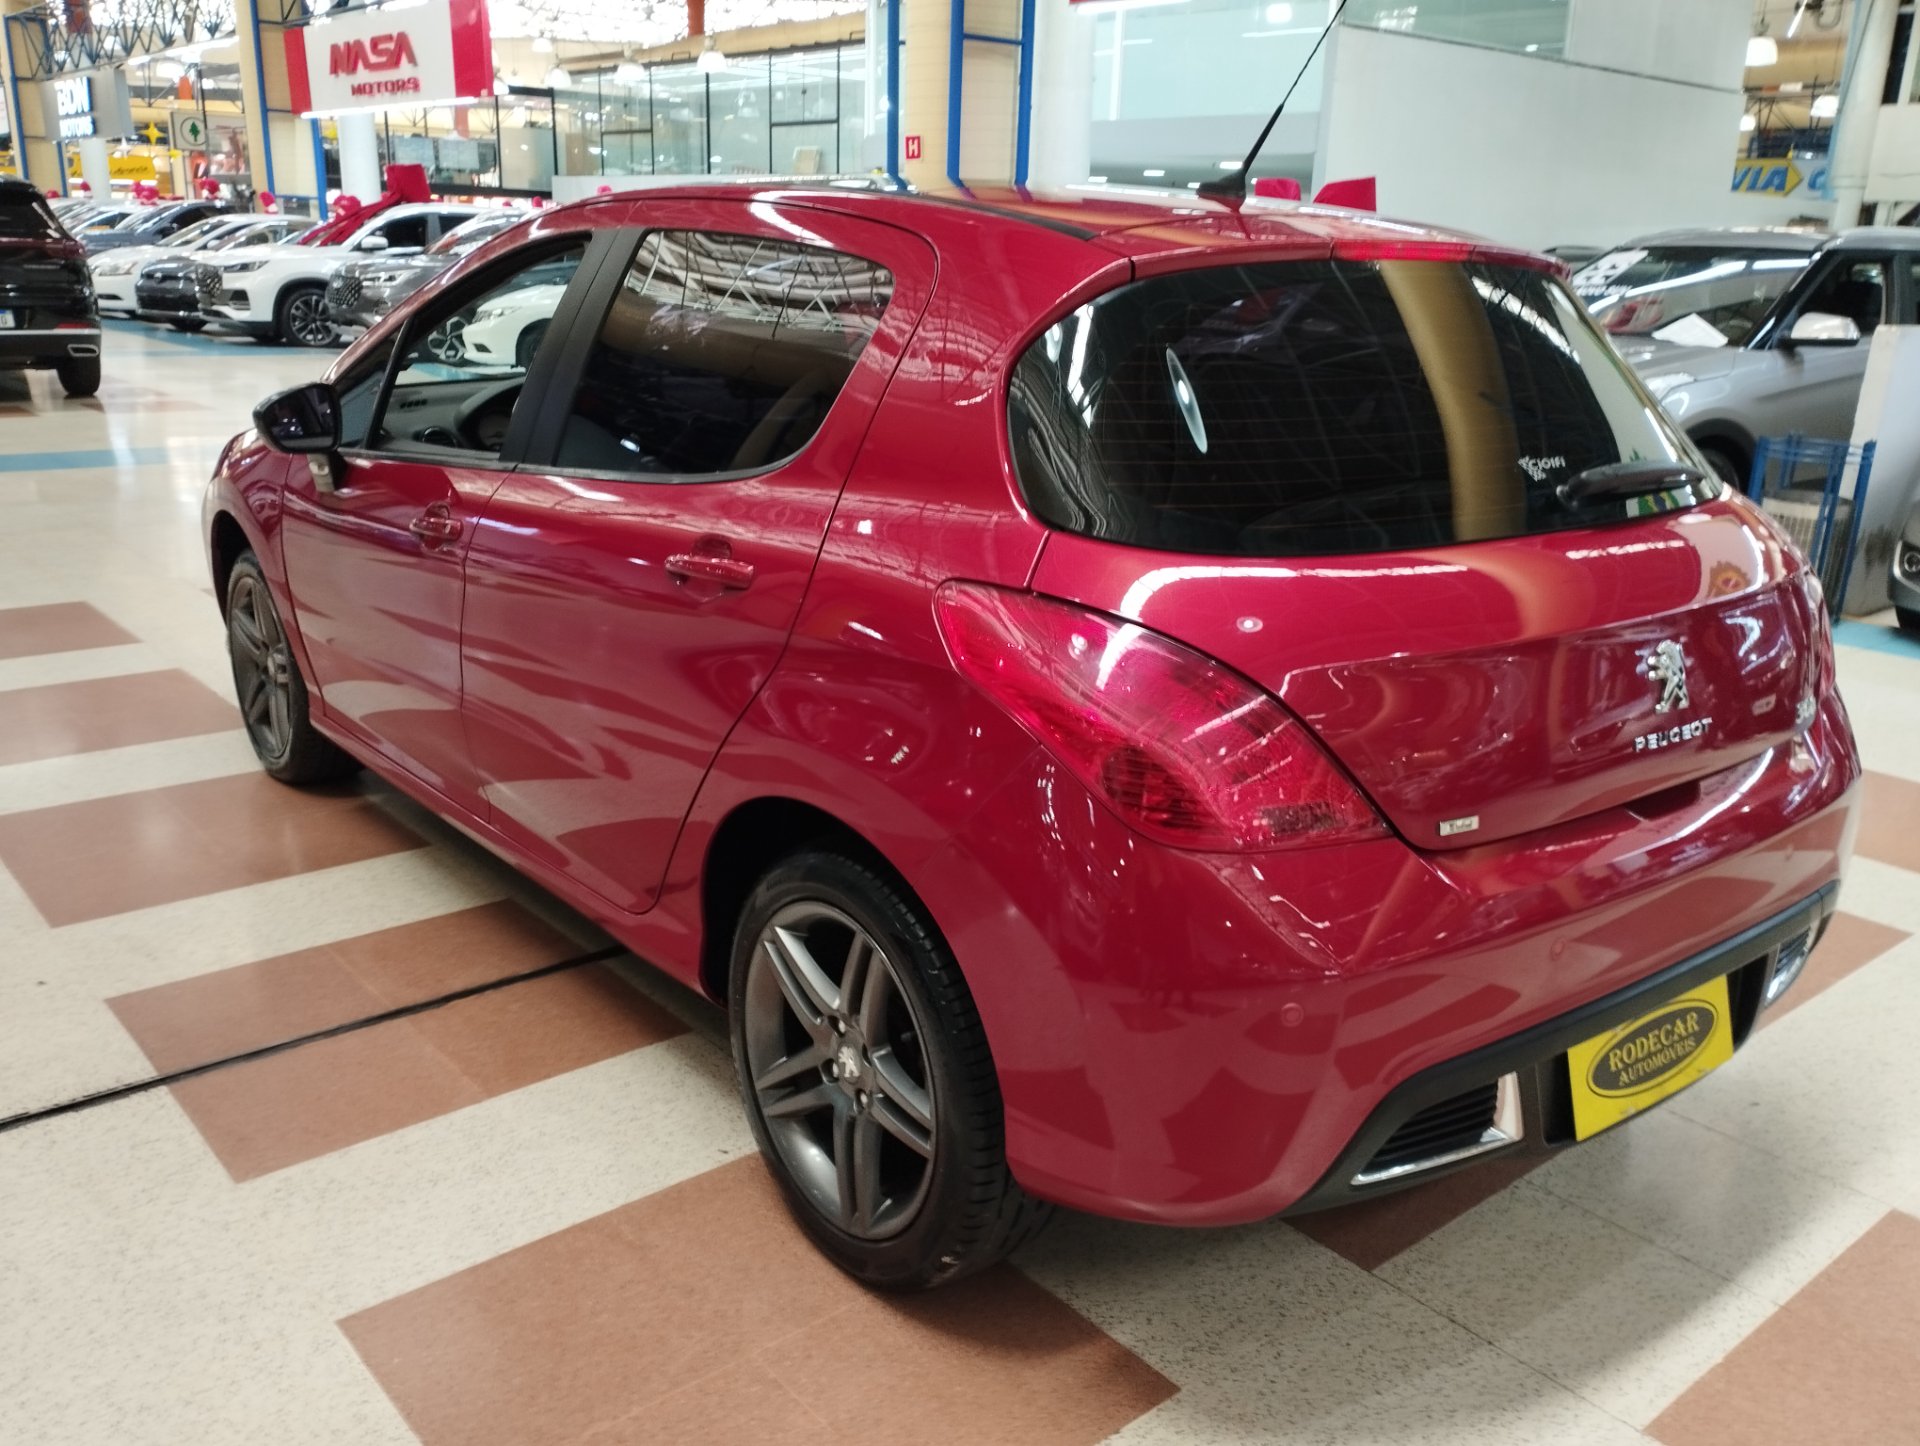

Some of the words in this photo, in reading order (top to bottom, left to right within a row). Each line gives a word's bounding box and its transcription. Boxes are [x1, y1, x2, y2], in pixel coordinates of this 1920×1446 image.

[330, 32, 417, 76] NASA
[351, 78, 420, 96] MOTORS
[1634, 717, 1713, 752] PEUGEOT
[1609, 1011, 1699, 1073] RODECAR
